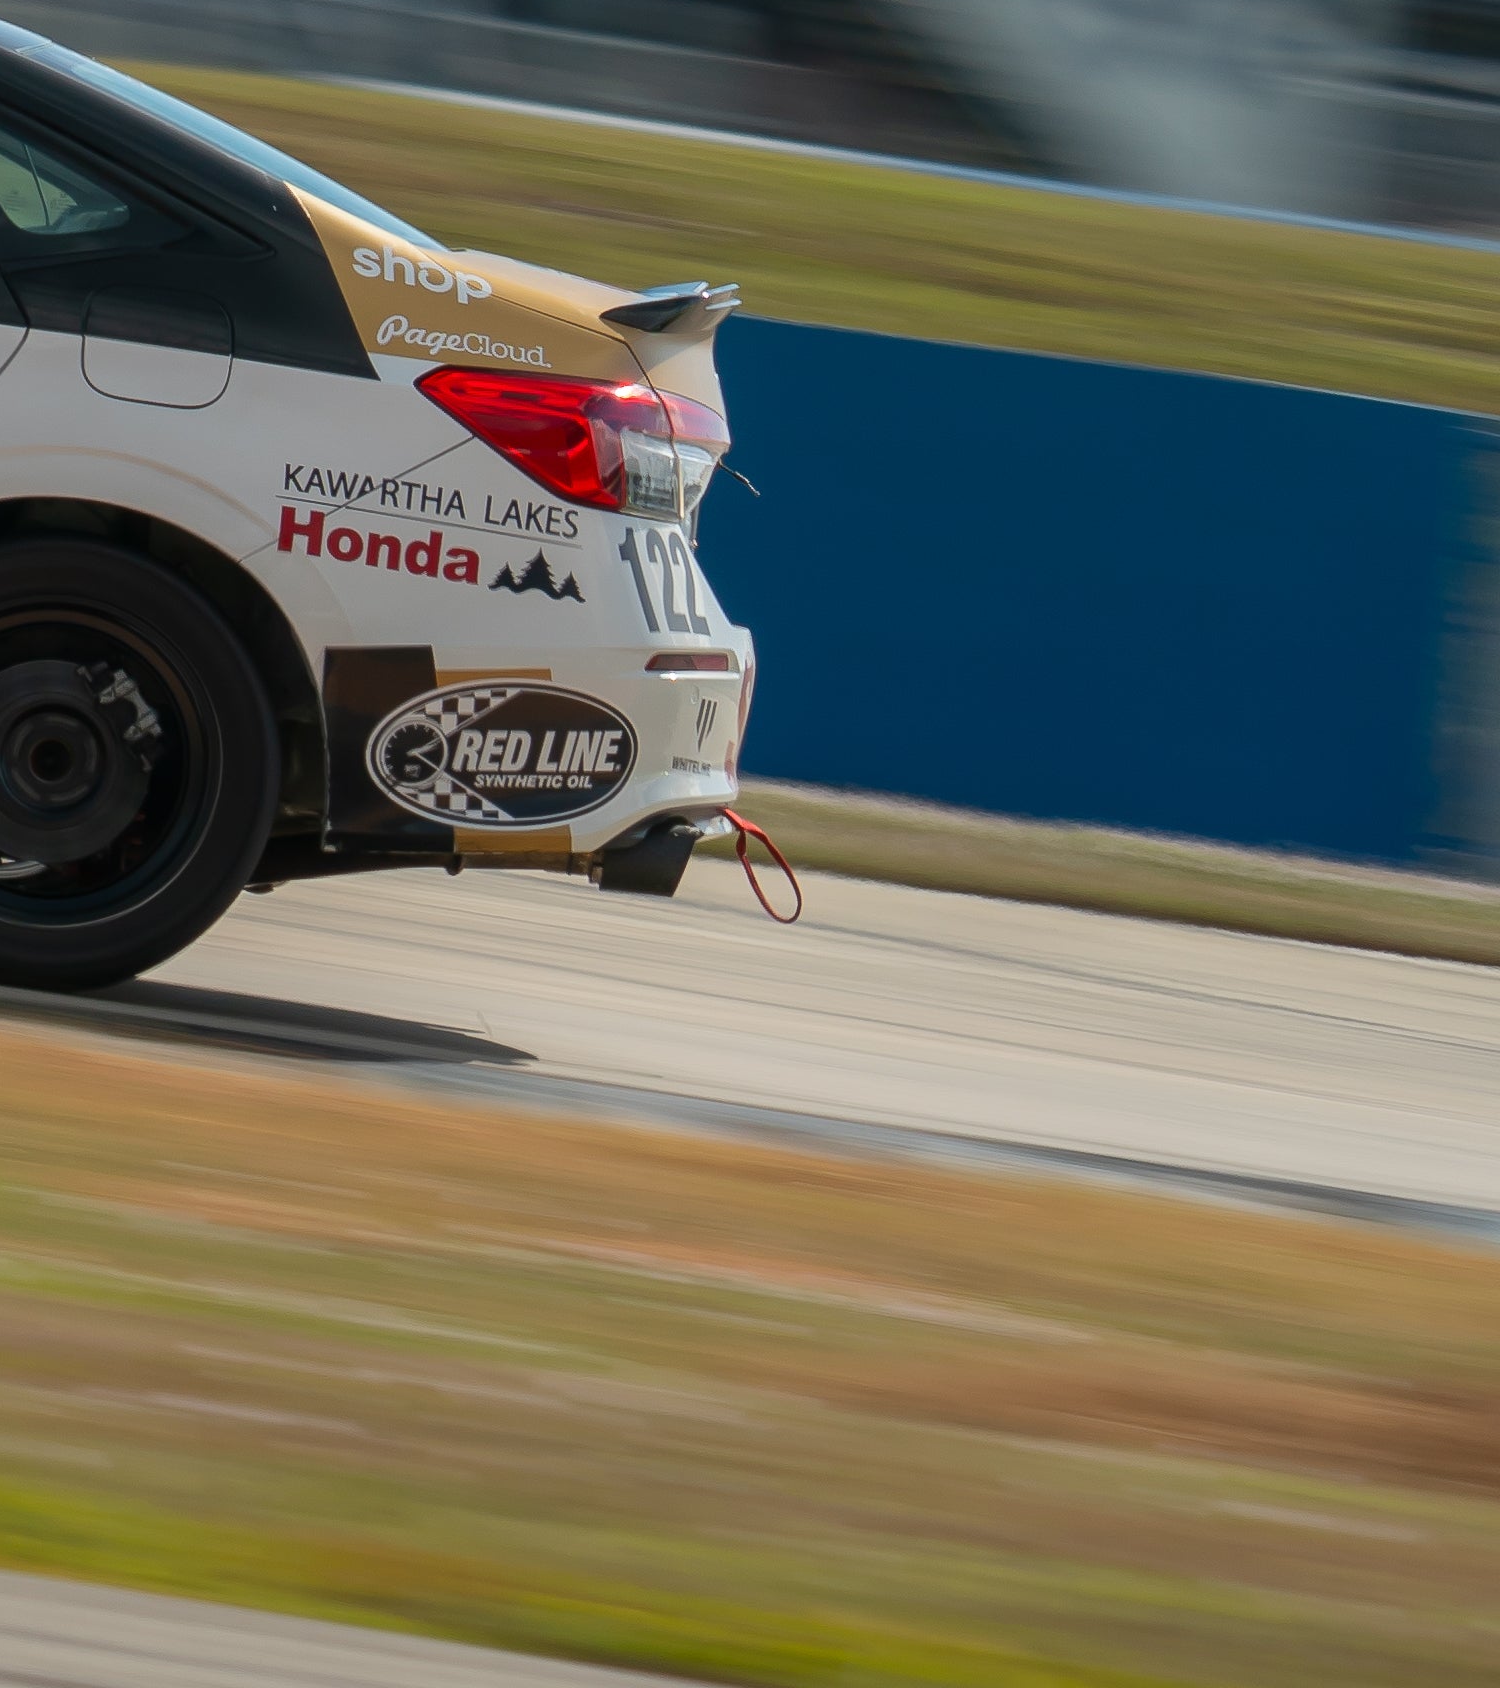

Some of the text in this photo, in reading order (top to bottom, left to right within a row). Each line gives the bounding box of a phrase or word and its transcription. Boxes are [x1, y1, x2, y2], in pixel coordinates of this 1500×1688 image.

[351, 247, 492, 305] shop
[284, 463, 580, 539] KAWARTHA LAKES
[277, 505, 480, 586] Honda
[618, 527, 712, 637] 122
[452, 729, 532, 772] RED
[474, 774, 593, 790] SYNTHETIC OIL
